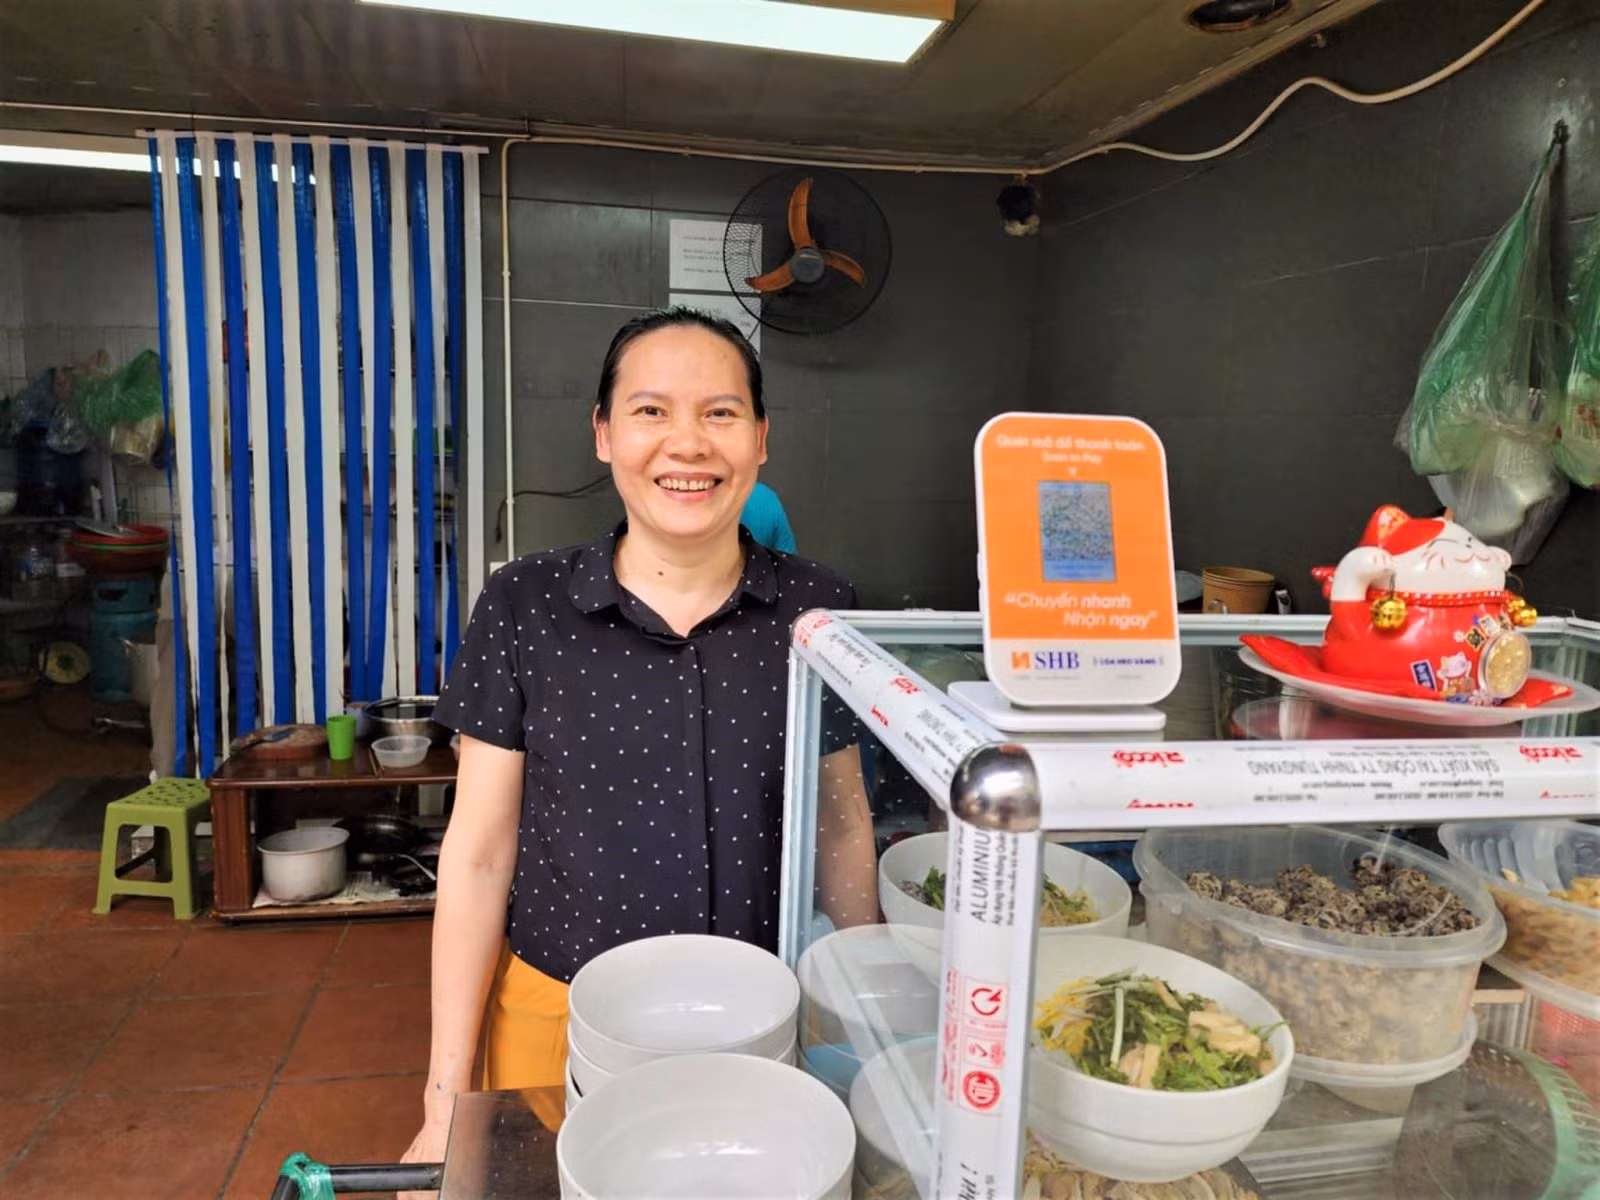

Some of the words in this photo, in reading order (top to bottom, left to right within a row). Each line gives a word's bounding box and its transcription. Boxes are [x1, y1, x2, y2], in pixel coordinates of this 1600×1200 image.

[1075, 437, 1113, 450] thanh
[1080, 594, 1131, 609] nhanh
[1035, 651, 1080, 670] SHB
[971, 826, 992, 923] ALUMINIU
